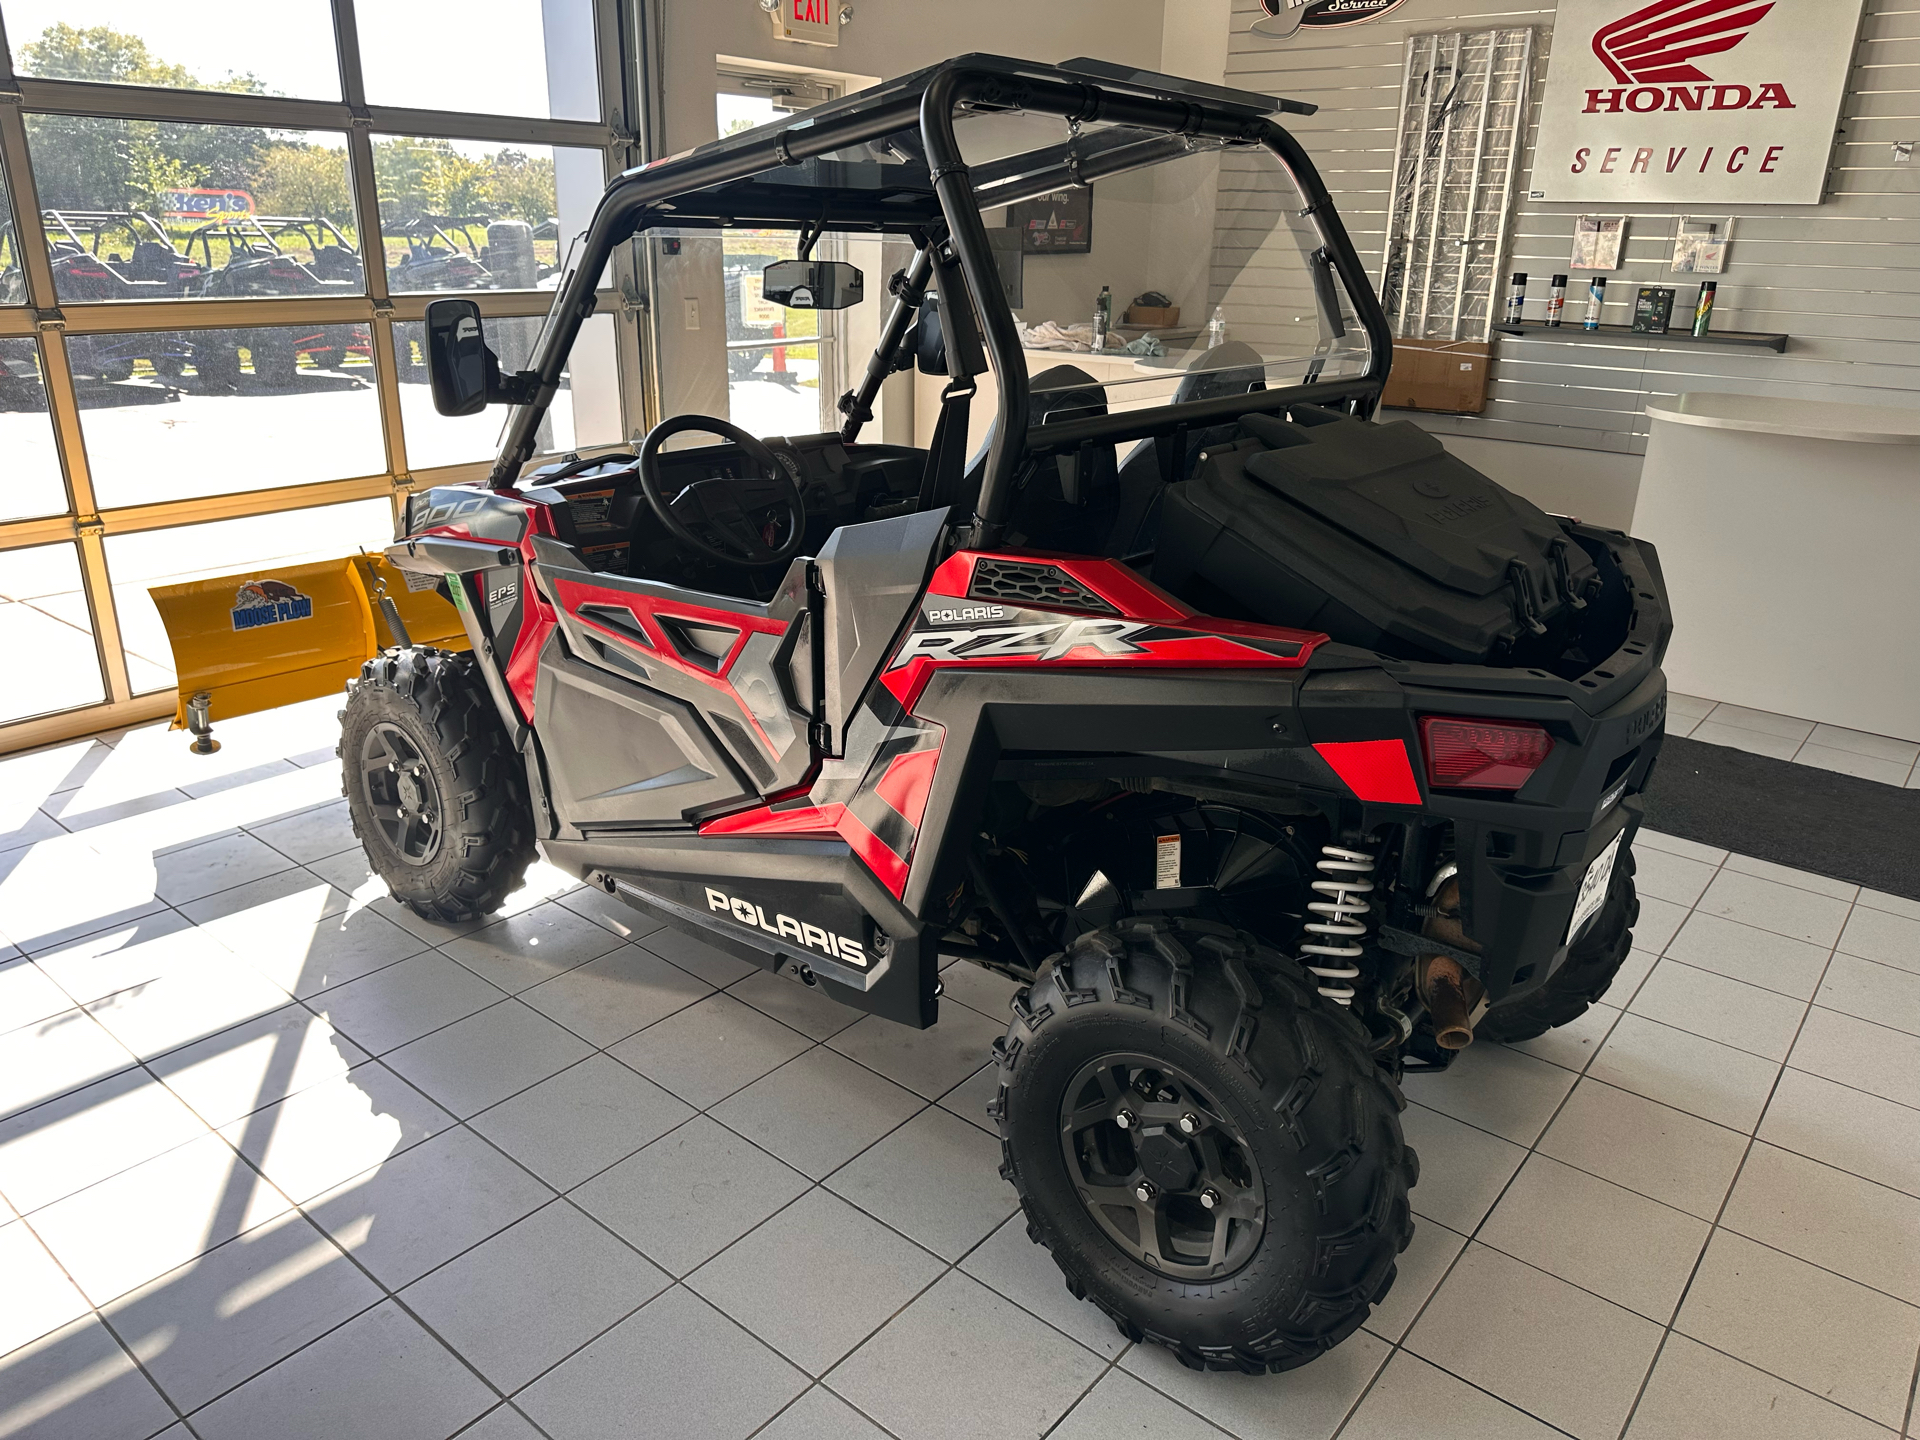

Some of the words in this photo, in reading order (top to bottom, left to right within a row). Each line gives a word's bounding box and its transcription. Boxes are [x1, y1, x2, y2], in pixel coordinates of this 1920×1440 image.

[1581, 83, 1796, 114] HONDA
[1571, 146, 1784, 174] SERVICE
[410, 496, 489, 534] 900
[489, 582, 516, 602] EPS
[233, 604, 278, 630] MOOSE
[276, 597, 312, 621] PLOW
[929, 605, 1004, 623] POLARIS
[885, 618, 1152, 672] RZR
[704, 886, 868, 967] POLARIS
